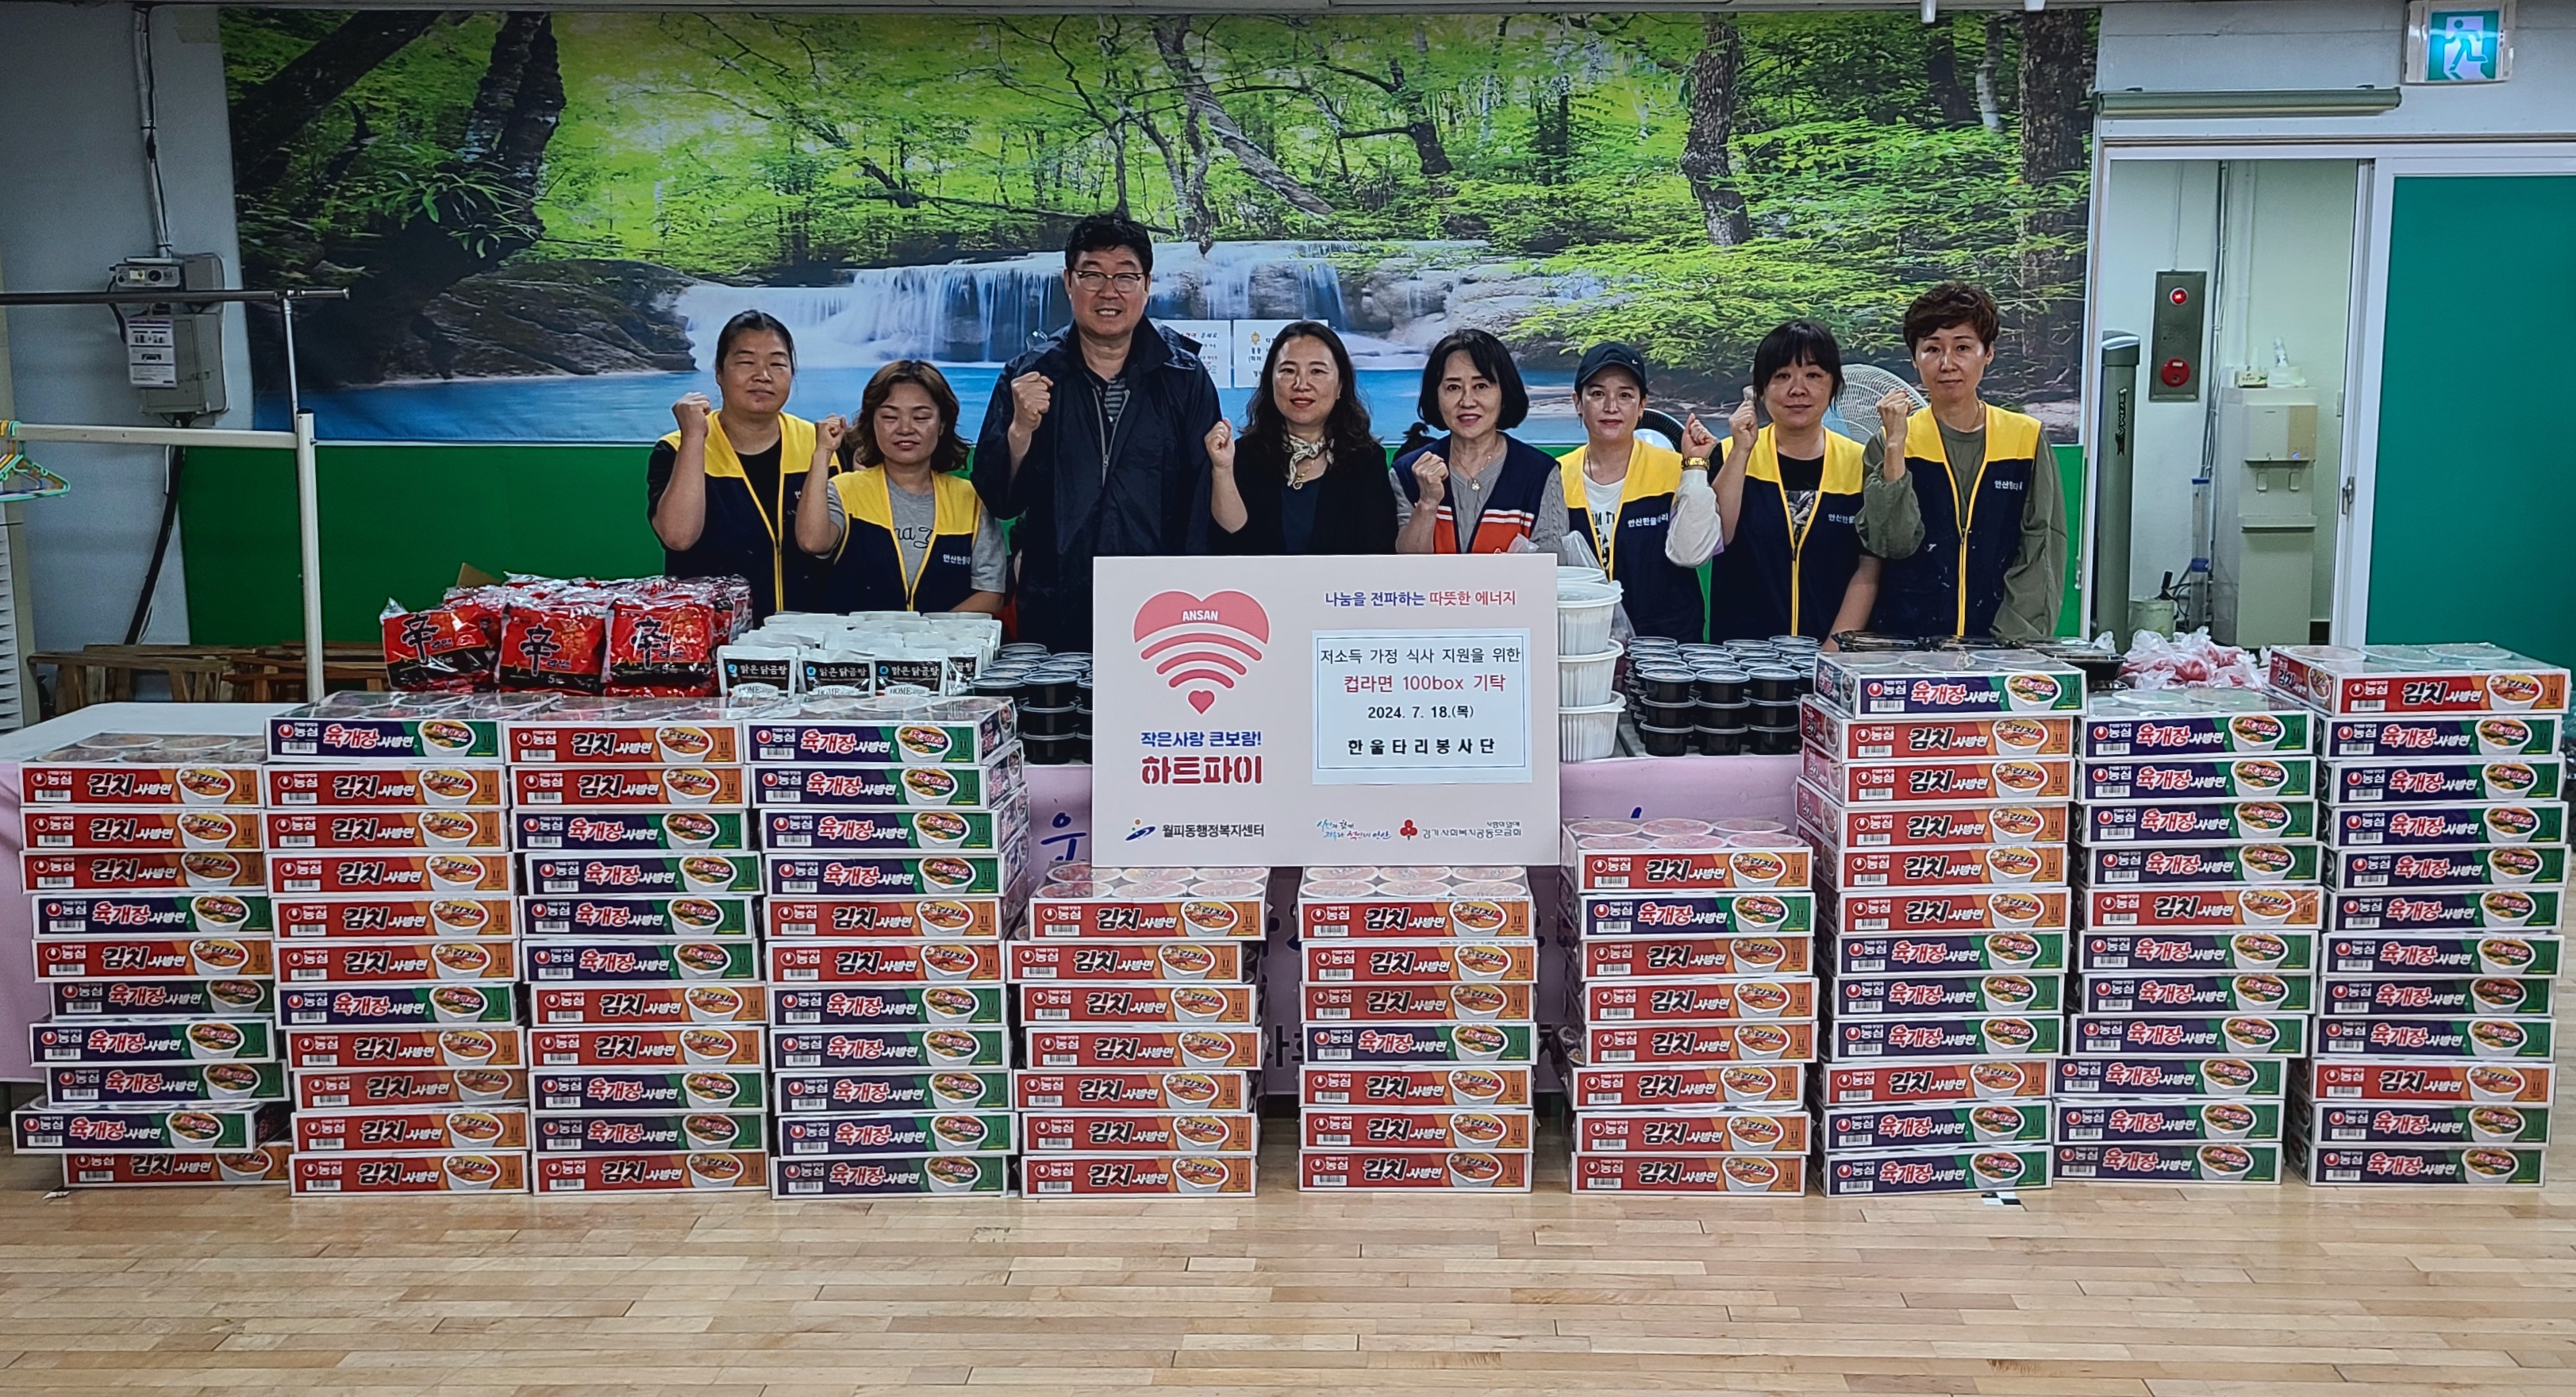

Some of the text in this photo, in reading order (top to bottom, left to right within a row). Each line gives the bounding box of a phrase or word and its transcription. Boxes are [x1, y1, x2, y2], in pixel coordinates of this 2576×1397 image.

[1325, 591, 1516, 607] 나눔을 전파하는 따뜻한 에너지
[1182, 610, 1218, 622] ANSAN
[402, 613, 439, 664] 辛
[520, 624, 561, 677] 辛
[1321, 647, 1521, 664] 저소득 가정 식사 지원을 위한
[1344, 674, 1506, 693] 컵라면 100box 기탁
[1911, 682, 2000, 704] 육개장 사발면
[2401, 681, 2482, 705] 김치 사발면
[1367, 706, 1405, 718] 2024.
[1412, 706, 1424, 718] 7.
[323, 724, 413, 749] 육개장 사발면
[801, 729, 890, 753] 육개장 사발면
[1141, 731, 1261, 747] 작은사랑 큰보람!
[1141, 756, 1262, 784] 하트파이
[2136, 767, 2226, 789] 육개장 사발면
[87, 773, 171, 797] 김치 사발면
[578, 775, 659, 798] 김치 사발면
[1162, 824, 1264, 837] 월피동행정복지센터
[1905, 815, 1985, 839] 김치 사발면
[336, 861, 422, 885] 김치 사발면
[824, 863, 913, 886] 육개장 사발면
[92, 902, 186, 924] 육개장 사발면
[575, 903, 663, 926] 육개장 사발면
[1095, 907, 1177, 930] 김치 사발면
[1637, 902, 1727, 925] 육개장 사발면
[2153, 895, 2234, 919] 김치 사발면
[1369, 952, 1450, 975] 김치 사발면
[1892, 941, 1980, 963] 육개장 사발면
[2379, 942, 2471, 965] 육개장 사발면
[333, 993, 425, 1015] 육개장 사발면
[827, 993, 917, 1016] 육개장 사발면
[87, 1030, 181, 1053] 육개장 사발면
[1651, 1032, 1730, 1055] 김치 사발면
[2127, 1022, 2217, 1045] 육개장 사발면
[594, 1036, 676, 1059] 김치 사발면
[1364, 1076, 1444, 1099] 김치 사발면
[1888, 1071, 1967, 1095] 김치 사발면
[2378, 1070, 2462, 1094] 김치 사발면
[360, 1119, 443, 1143] 김치 사발면
[835, 1122, 926, 1145] 육개장 사발면
[601, 1160, 682, 1183] 김치 사발면
[2102, 1149, 2192, 1171] 육개장 사발면
[1637, 1161, 1717, 1184] 김치 사발면
